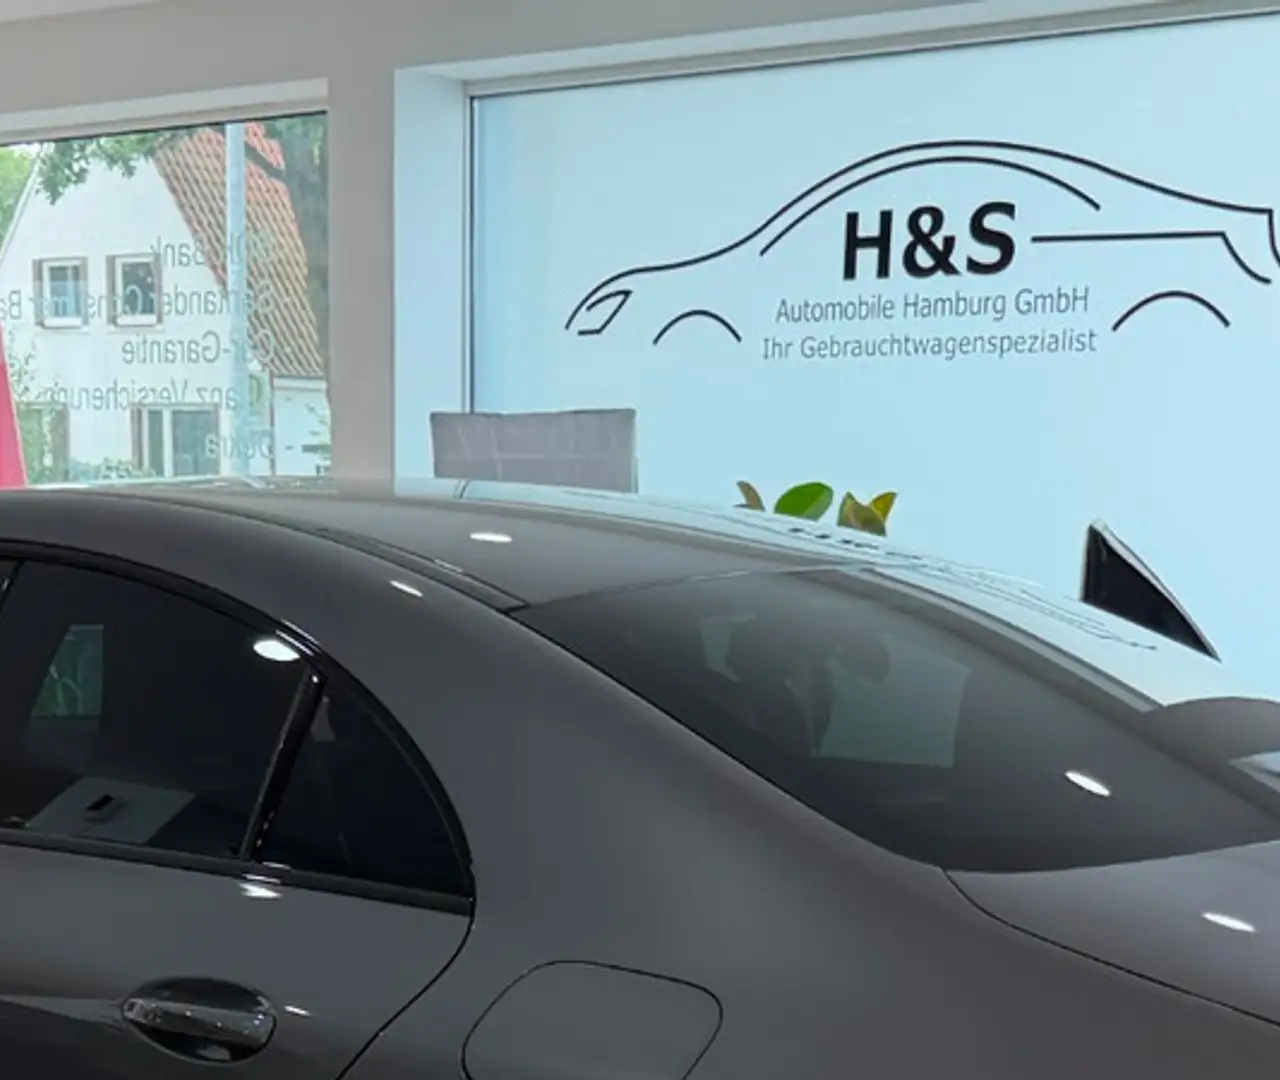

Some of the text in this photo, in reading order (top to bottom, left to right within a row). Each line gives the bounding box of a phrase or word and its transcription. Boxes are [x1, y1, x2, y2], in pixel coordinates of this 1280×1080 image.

[843, 201, 1016, 281] H&S
[776, 286, 1089, 323] Automobile Hamburg GmbH
[764, 329, 1097, 361] Ihr Gebrauchtwagenspezialist
